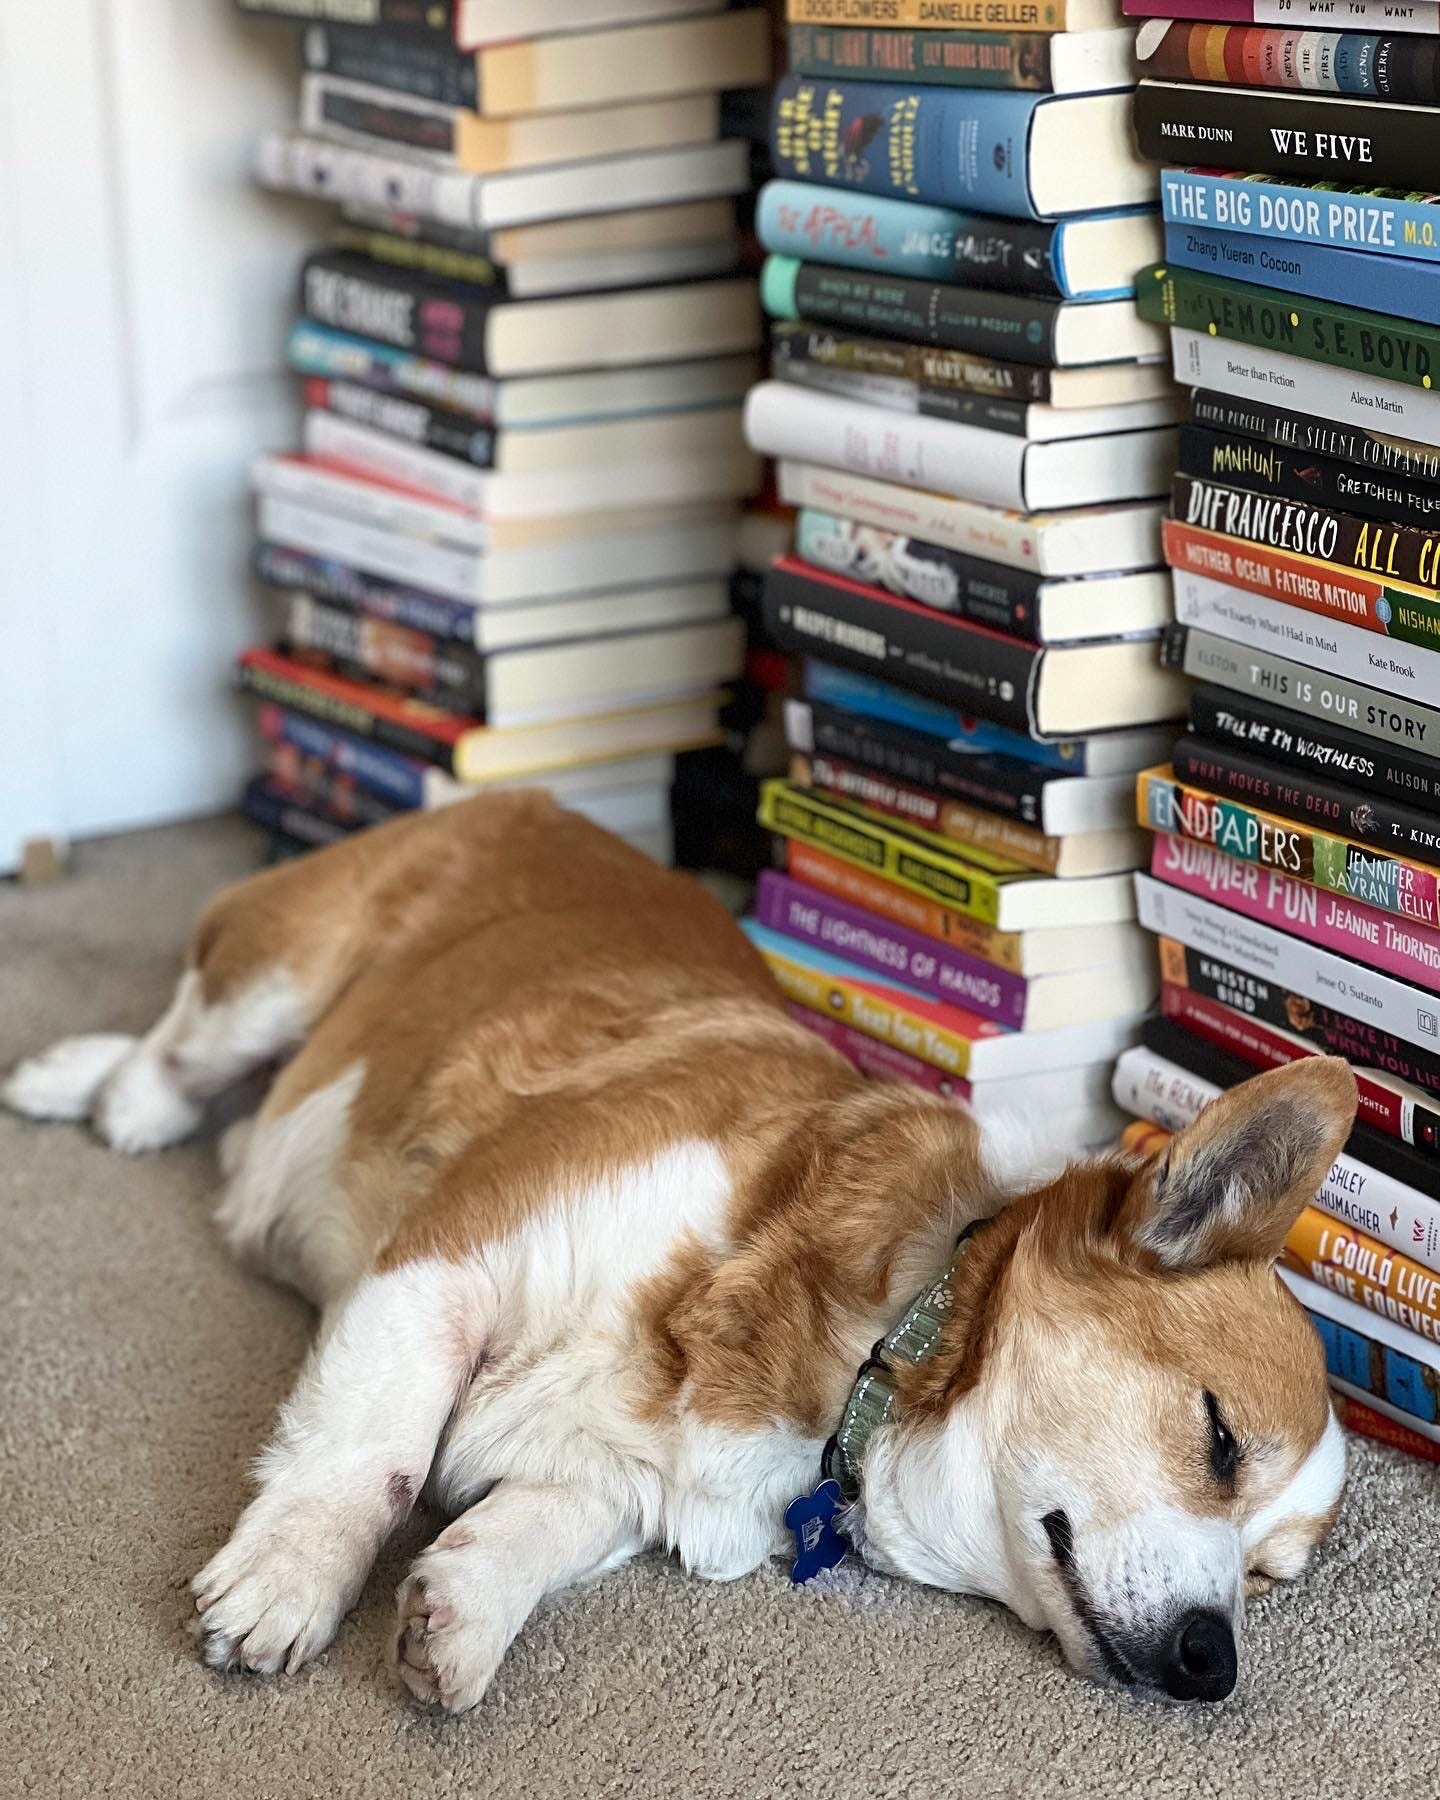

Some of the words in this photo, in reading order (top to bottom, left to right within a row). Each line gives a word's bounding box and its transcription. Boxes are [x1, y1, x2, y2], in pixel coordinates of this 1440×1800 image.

[837, 1, 898, 19] FLOWERS
[919, 2, 983, 22] DANIELLE
[986, 5, 1038, 23] GELLER
[1279, 0, 1291, 10] DO
[1309, 2, 1335, 13] WHAT
[1350, 3, 1366, 14] YOU
[1385, 7, 1414, 18] WANT
[1321, 45, 1330, 79] FIRST
[1360, 42, 1371, 88] WENDY
[1381, 42, 1392, 93] GUERRA
[1161, 122, 1195, 139] MARK
[1198, 126, 1233, 142] DUNN
[1270, 128, 1307, 155] WE
[1315, 133, 1372, 163] FIVE
[1167, 182, 1208, 220] THE
[1215, 189, 1251, 226] BIG
[1260, 195, 1320, 237] DOOR
[1328, 203, 1395, 247] PRIZE
[1405, 220, 1438, 246] M.O.
[1187, 235, 1217, 262] Zhang
[1220, 242, 1255, 265] Yueran
[1260, 250, 1301, 275] Cocoon
[1206, 297, 1294, 344] LEMON
[1360, 330, 1431, 376] BOYD
[1227, 361, 1250, 379] Better
[1251, 366, 1268, 383] than
[1269, 370, 1296, 388] Fiction
[1350, 391, 1374, 408] Alexa
[1375, 398, 1404, 414] Martin
[1195, 402, 1224, 421] LAURA
[1227, 409, 1266, 432] PURCELL
[1273, 418, 1299, 444] THE
[1307, 426, 1358, 458] SILENT
[1212, 445, 1284, 483] MANHUNT
[1337, 473, 1402, 504] GRETCHEN
[1186, 481, 1338, 559] DIFRANCESCO
[1354, 522, 1399, 575] ALL
[1186, 542, 1233, 577] MOTHER
[1235, 555, 1271, 587] OCEAN
[1275, 568, 1321, 605] FATHER
[1323, 584, 1368, 617] NATION
[1398, 607, 1440, 634] NISHAN
[1258, 617, 1280, 635] What
[1287, 627, 1304, 643] Had
[1305, 633, 1314, 646] in
[1315, 636, 1338, 653] Mind
[1368, 653, 1388, 672] Kate
[1389, 659, 1416, 680] Brook
[1250, 665, 1288, 694] THIS
[1296, 681, 1312, 702] IS
[1320, 690, 1358, 719] OUR
[1367, 705, 1427, 741] STORY
[1216, 711, 1247, 737] TELL
[1250, 722, 1269, 743] ME
[1272, 729, 1293, 752] I'M
[1297, 737, 1375, 778] WORTHLESS
[1386, 767, 1428, 793] ALISON
[1188, 757, 1223, 781] WHAT
[1228, 768, 1270, 796] MOVES
[1277, 785, 1300, 807] THE
[1306, 798, 1340, 819] DEAD
[1391, 823, 1403, 837] T.
[1152, 787, 1301, 871] ENDPAPERS
[1165, 838, 1258, 900] SUMMER
[1267, 872, 1318, 928] FUN
[1325, 900, 1379, 945] JEANNE
[1328, 867, 1390, 907] SAVRAN
[1397, 889, 1433, 922] KELLY
[1347, 850, 1414, 891] JENNIFER
[788, 902, 819, 934] THE
[821, 915, 908, 971] LIGHTNESS
[911, 954, 934, 978] OF
[939, 965, 1001, 1008] HANDS
[1200, 960, 1268, 1000] KRISTEN
[1217, 985, 1256, 1013] BIRD
[1316, 970, 1336, 989] Jesse
[1349, 986, 1383, 1010] Sutanto
[1321, 1009, 1329, 1022] I
[1335, 1015, 1376, 1045] LOVE
[1383, 1035, 1399, 1053] IT
[1324, 1029, 1372, 1060] WHEN
[1377, 1052, 1410, 1077] YOU
[1358, 1093, 1389, 1117] UGHTER
[1329, 1164, 1366, 1196] SHLEY
[1313, 1188, 1381, 1234] HUMACHER
[1311, 1260, 1360, 1301] HERE
[1319, 1230, 1328, 1256] I
[1332, 1236, 1393, 1286] COULD
[1397, 1267, 1440, 1310] LIVE
